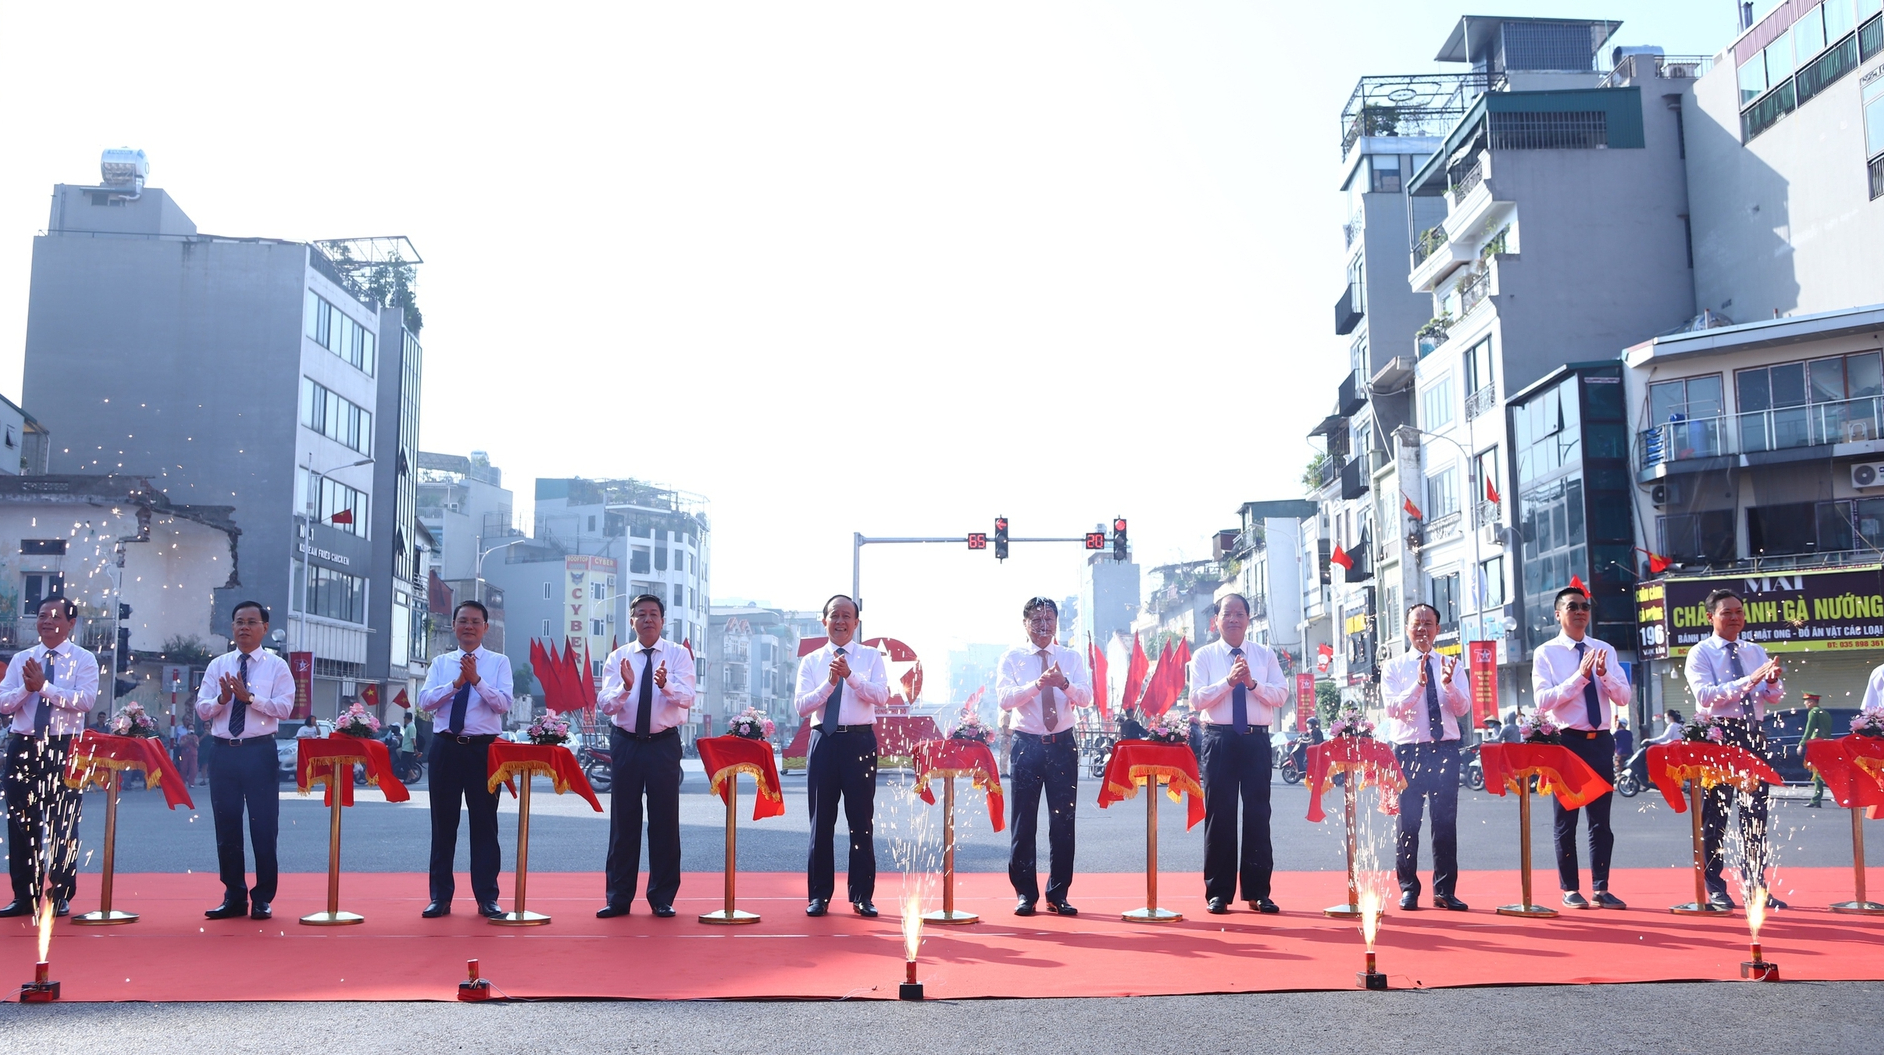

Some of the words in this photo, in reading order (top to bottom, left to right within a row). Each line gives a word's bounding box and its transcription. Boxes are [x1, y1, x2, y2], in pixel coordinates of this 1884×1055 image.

[299, 524, 314, 541] N.1
[968, 534, 986, 549] 65
[1087, 534, 1104, 548] 20
[299, 543, 318, 557] KOEAN
[318, 549, 331, 561] FRIED
[331, 553, 350, 566] CHICKEN
[594, 557, 614, 566] CYBER
[1743, 575, 1805, 593] MAI
[1673, 601, 1713, 628] CHÂ
[1742, 598, 1778, 624] ÁNH
[1782, 594, 1809, 622] GÀ
[1814, 591, 1884, 620] NƯỚNG
[1639, 624, 1665, 646] 196
[1677, 632, 1699, 644] BÁNH
[1773, 629, 1791, 639] ONG
[1812, 625, 1824, 637] ĂN
[1843, 624, 1862, 636] CÁC
